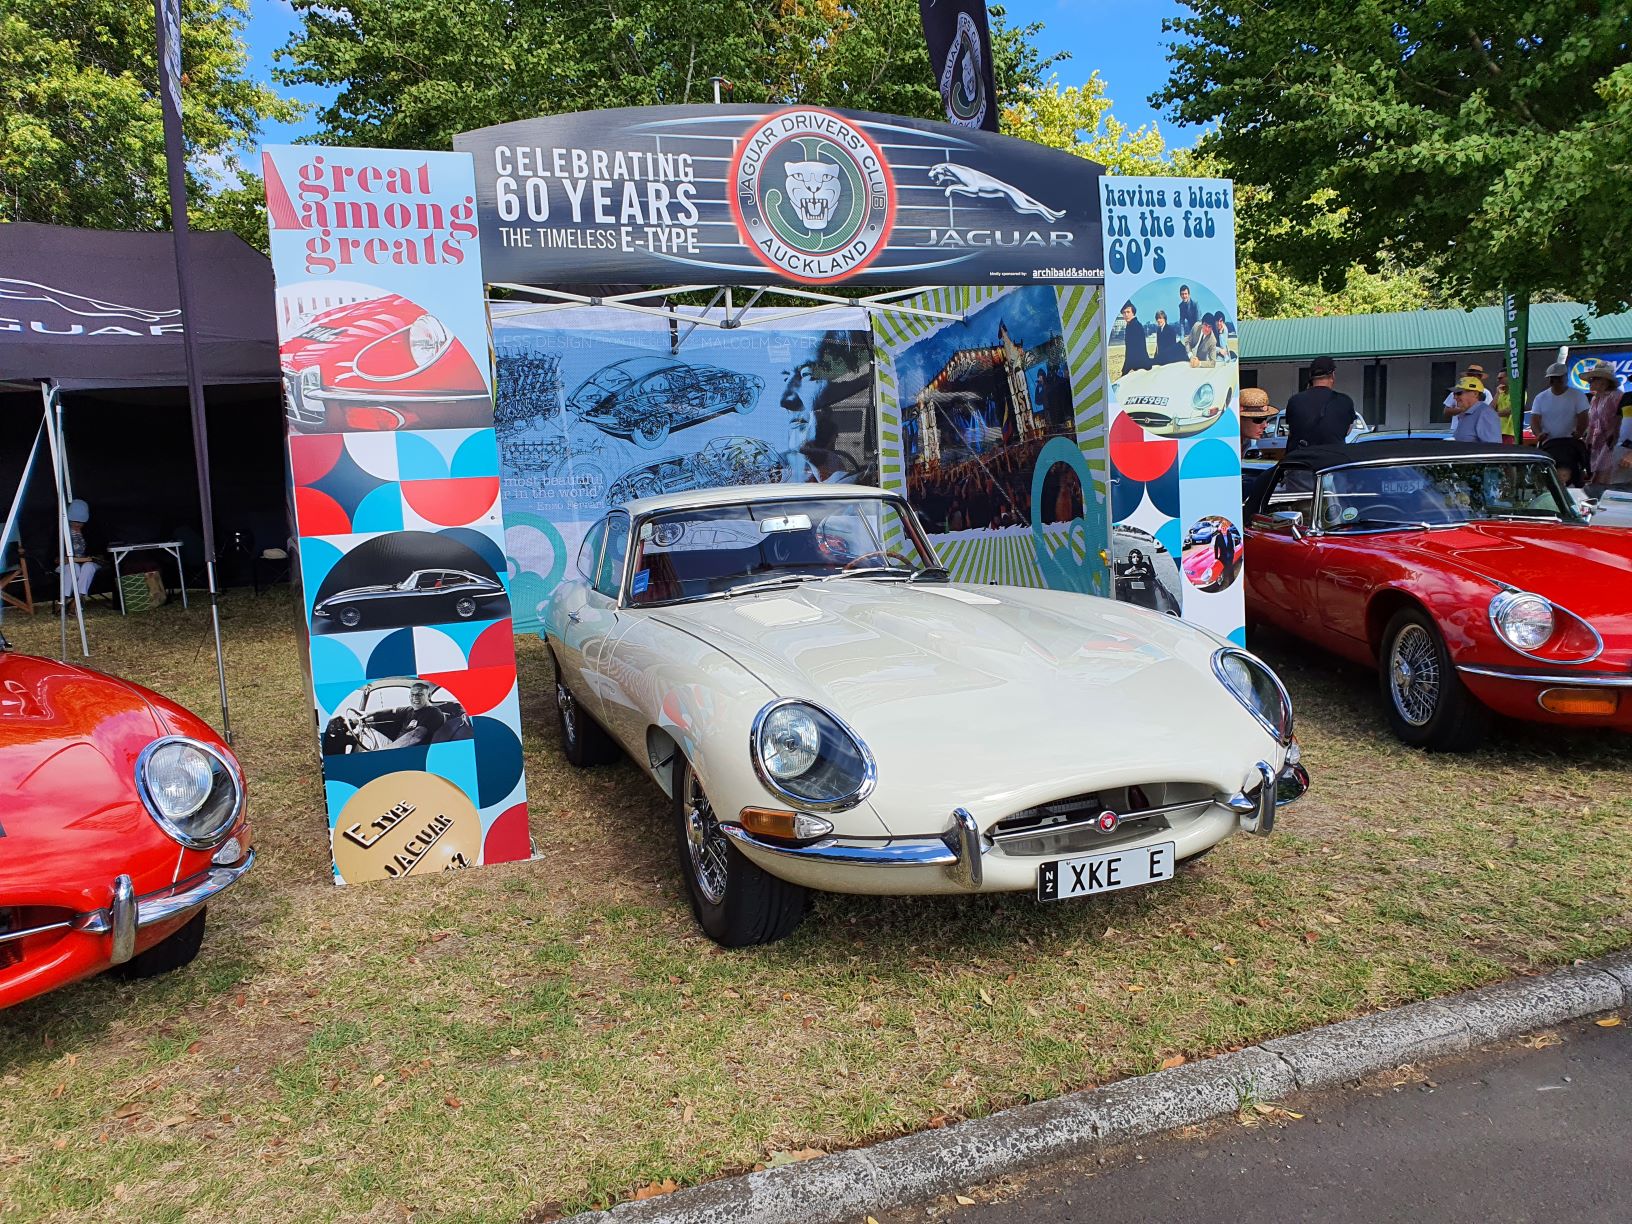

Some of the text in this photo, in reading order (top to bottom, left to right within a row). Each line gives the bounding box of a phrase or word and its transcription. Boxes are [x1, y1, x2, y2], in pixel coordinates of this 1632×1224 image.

[298, 155, 434, 201] great
[495, 146, 694, 182] CELEBRATING
[739, 127, 778, 205] JAGUAR
[863, 155, 886, 209] CLUB
[496, 176, 699, 226] 60 YEARS
[1105, 184, 1229, 209] having a blast
[300, 196, 478, 240] among
[1107, 208, 1215, 238] in the fab
[305, 229, 464, 275] greats
[499, 226, 700, 254] THE TIMELESS E-TYPE
[760, 240, 867, 273] AUCKLAND
[916, 229, 1075, 248] JAGUAR
[1108, 238, 1166, 275] 60's
[535, 336, 592, 349] DESIGN
[701, 336, 770, 350] MALCOLM
[774, 336, 818, 350] SAYER
[1508, 326, 1520, 379] Lotus
[504, 473, 603, 487] most beautiful
[513, 488, 529, 499] in
[532, 486, 555, 498] the
[343, 800, 417, 849] E TYPE
[1070, 849, 1164, 893] XKE E
